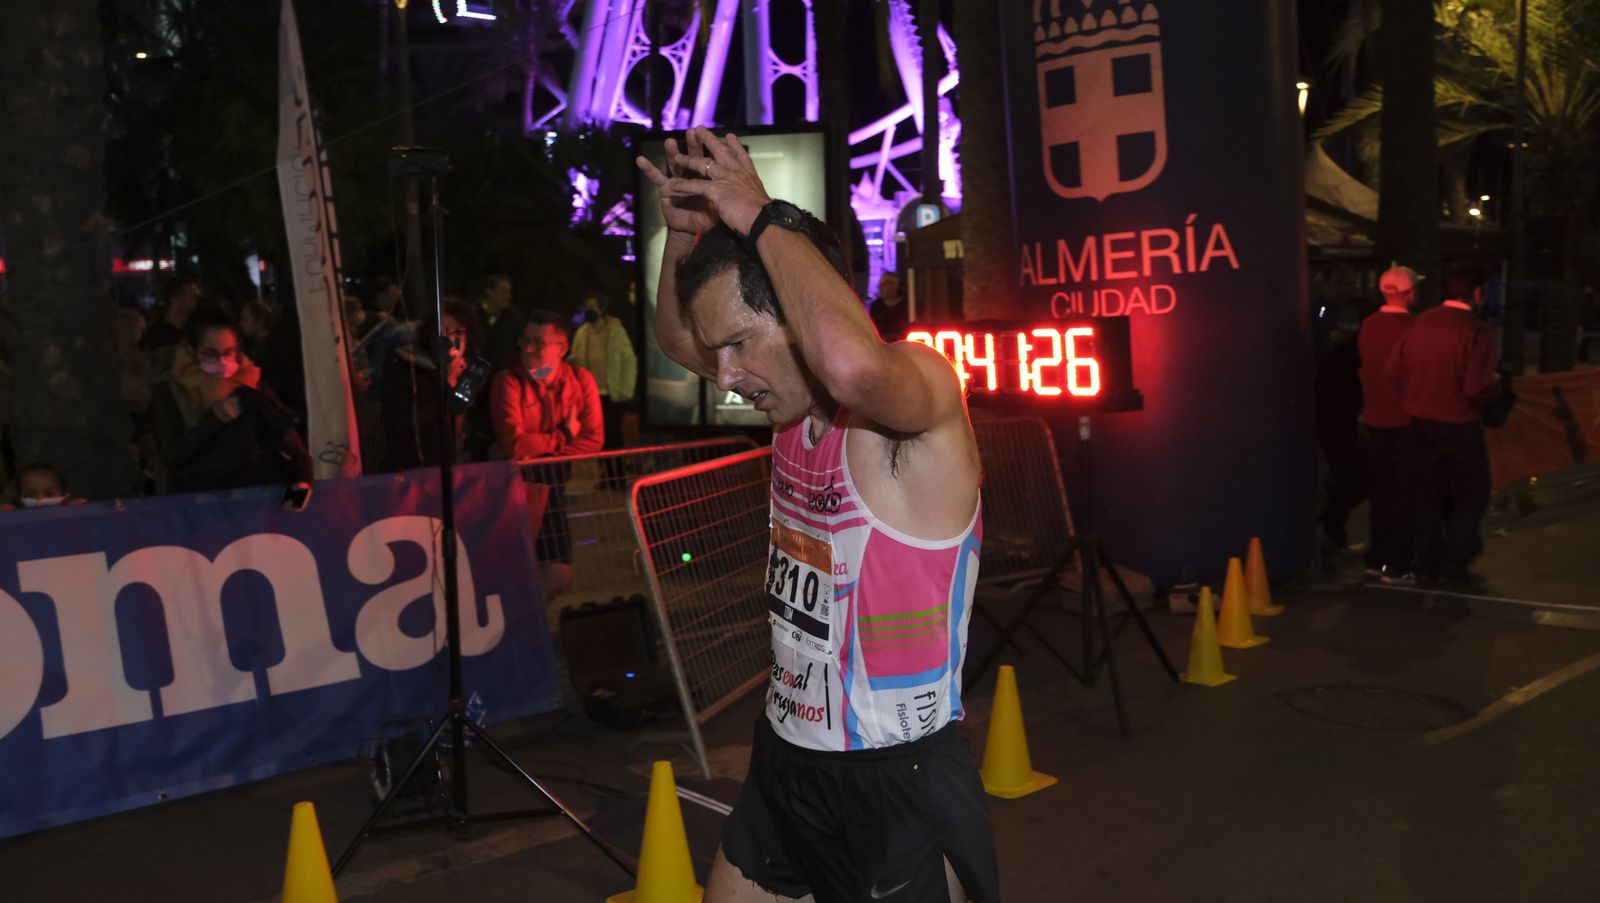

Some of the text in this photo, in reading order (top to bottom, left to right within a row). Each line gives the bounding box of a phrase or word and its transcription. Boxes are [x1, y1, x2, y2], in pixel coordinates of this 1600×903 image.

[1020, 213, 1241, 287] ALMERÍA
[1051, 285, 1177, 318] CIUDAD
[775, 556, 819, 612] 310
